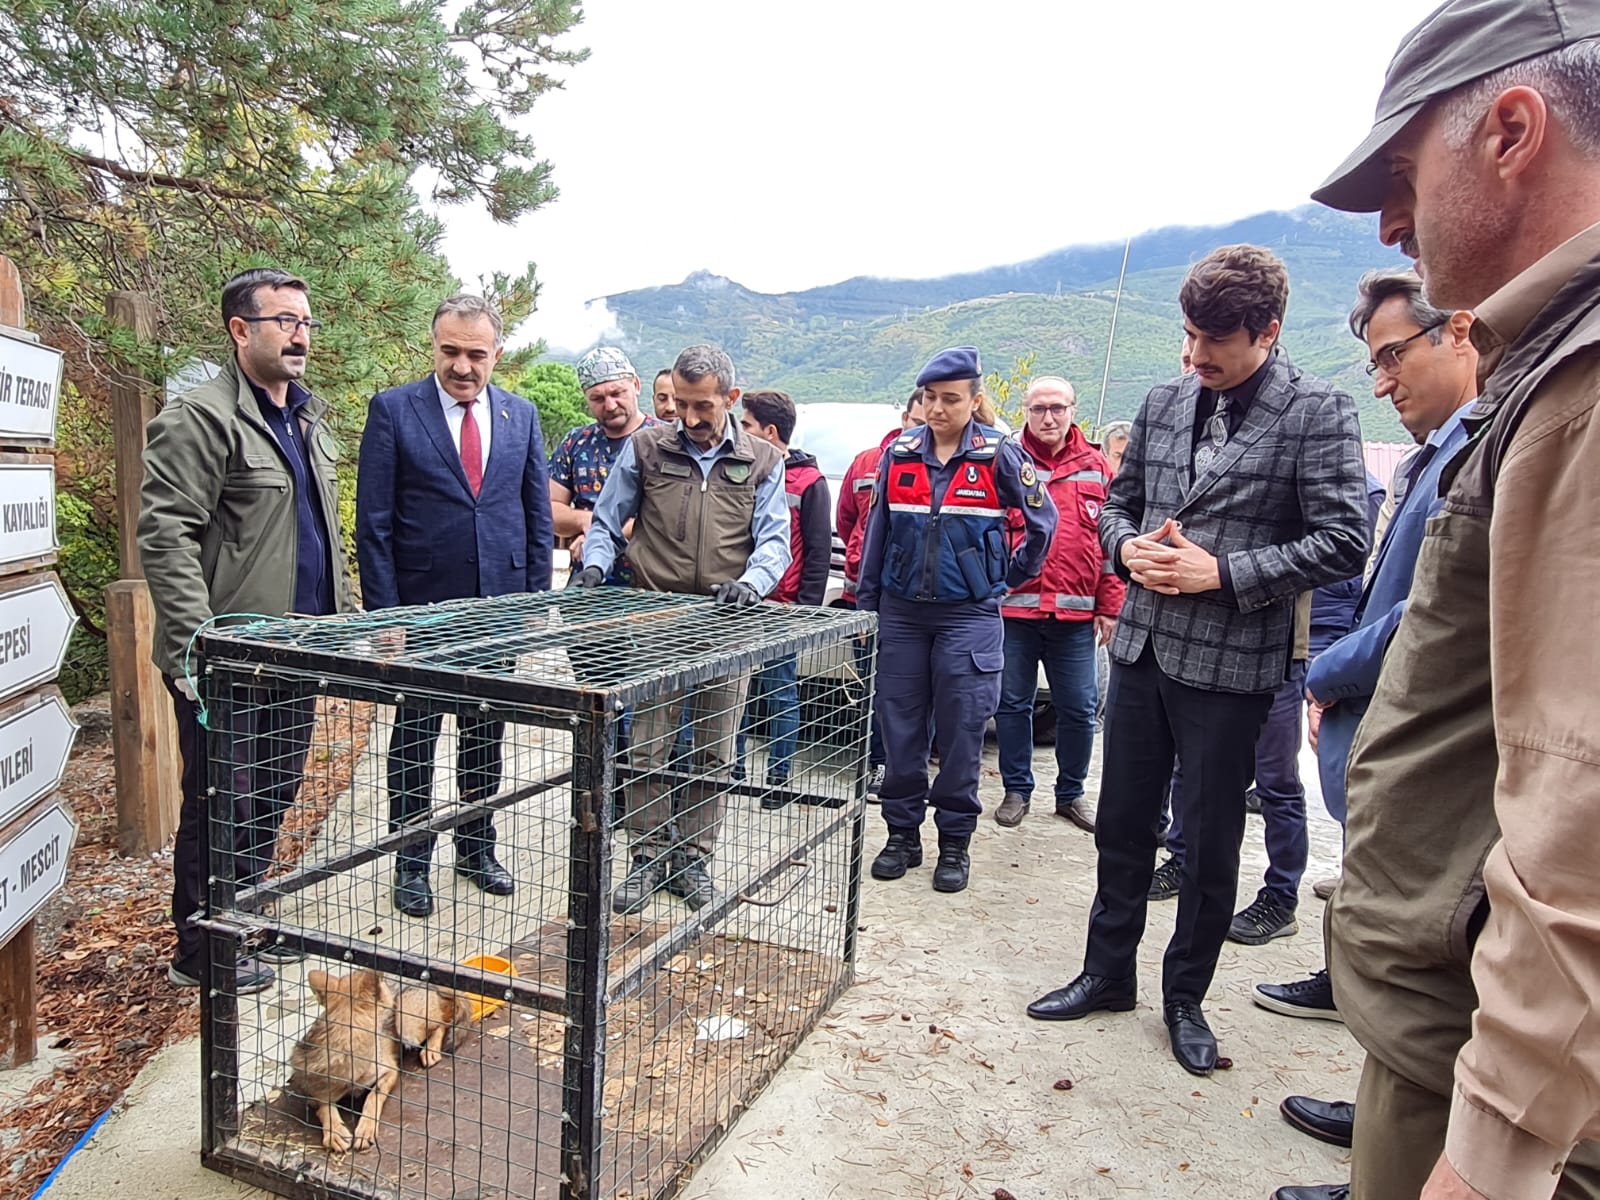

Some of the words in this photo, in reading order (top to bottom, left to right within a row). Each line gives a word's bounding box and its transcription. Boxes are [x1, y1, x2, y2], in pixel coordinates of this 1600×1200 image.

[0, 365, 12, 403] İR
[15, 376, 52, 410] TERASI
[3, 496, 49, 533] KAYALIĞI
[0, 737, 33, 791] VLERİ
[20, 833, 60, 894] MESCİT
